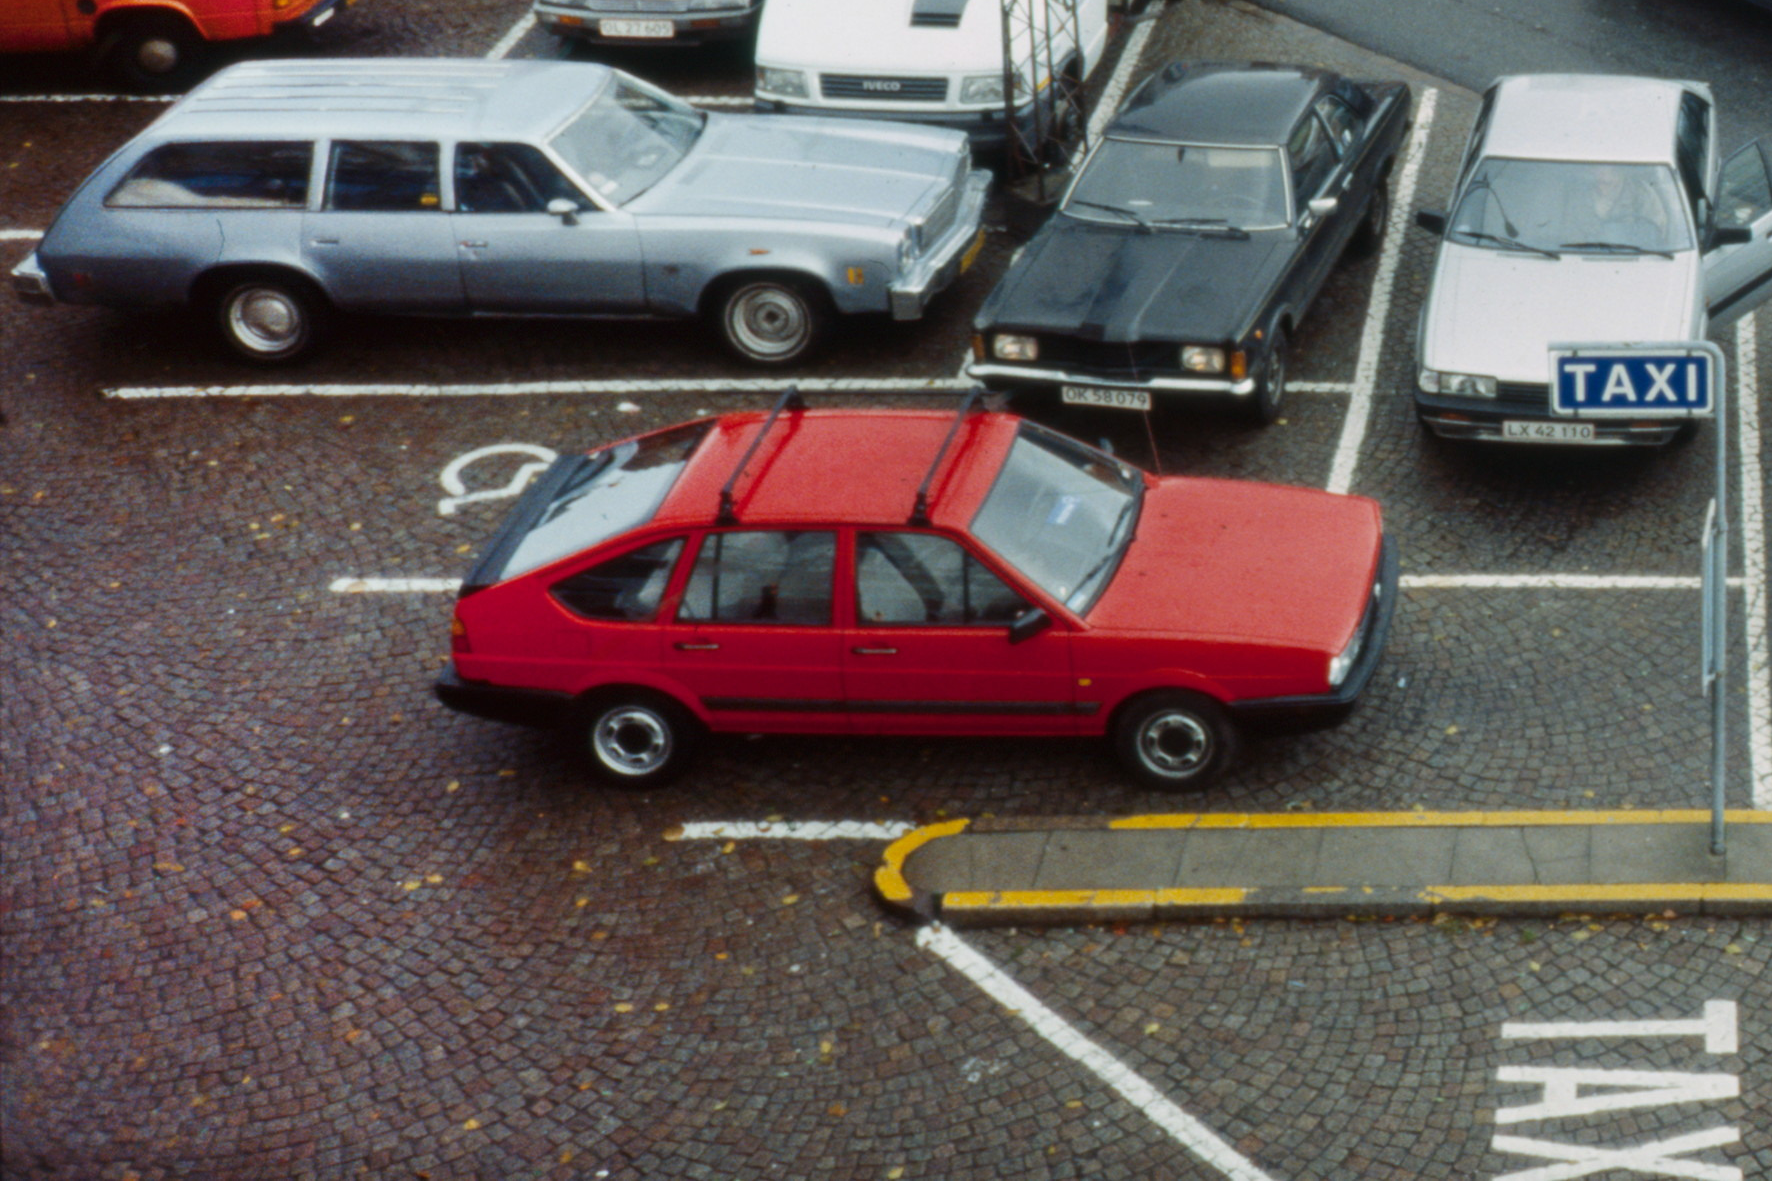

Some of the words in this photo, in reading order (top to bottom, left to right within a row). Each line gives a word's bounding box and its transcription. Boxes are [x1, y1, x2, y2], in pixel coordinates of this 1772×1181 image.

[862, 81, 901, 91] IVECO
[1563, 363, 1698, 402] TAXI
[1066, 387, 1088, 402] OK
[1092, 388, 1112, 404] 58
[1115, 391, 1147, 407] 079
[1507, 422, 1531, 437] LX
[1534, 424, 1556, 438] 42
[1561, 425, 1592, 439] 110
